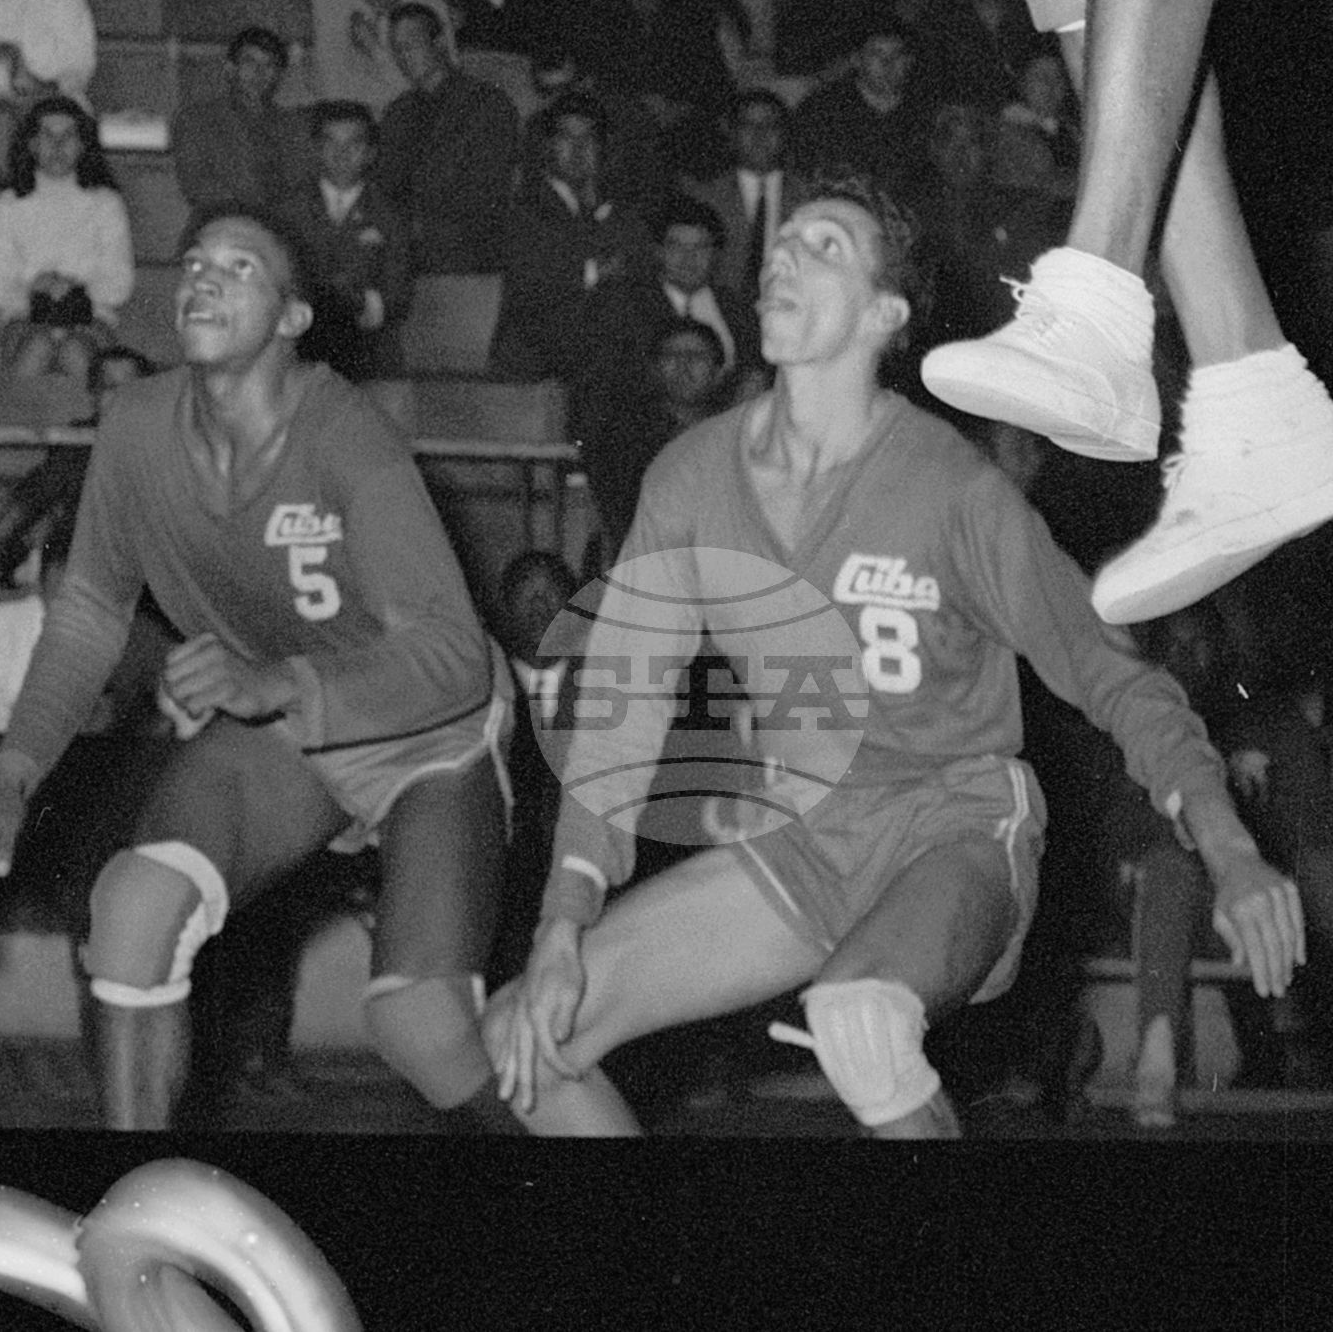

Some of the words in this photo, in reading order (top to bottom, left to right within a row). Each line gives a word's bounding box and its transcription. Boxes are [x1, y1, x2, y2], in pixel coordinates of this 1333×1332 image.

[288, 544, 342, 622] 5
[832, 552, 941, 612] Cuba
[858, 605, 922, 694] 8
